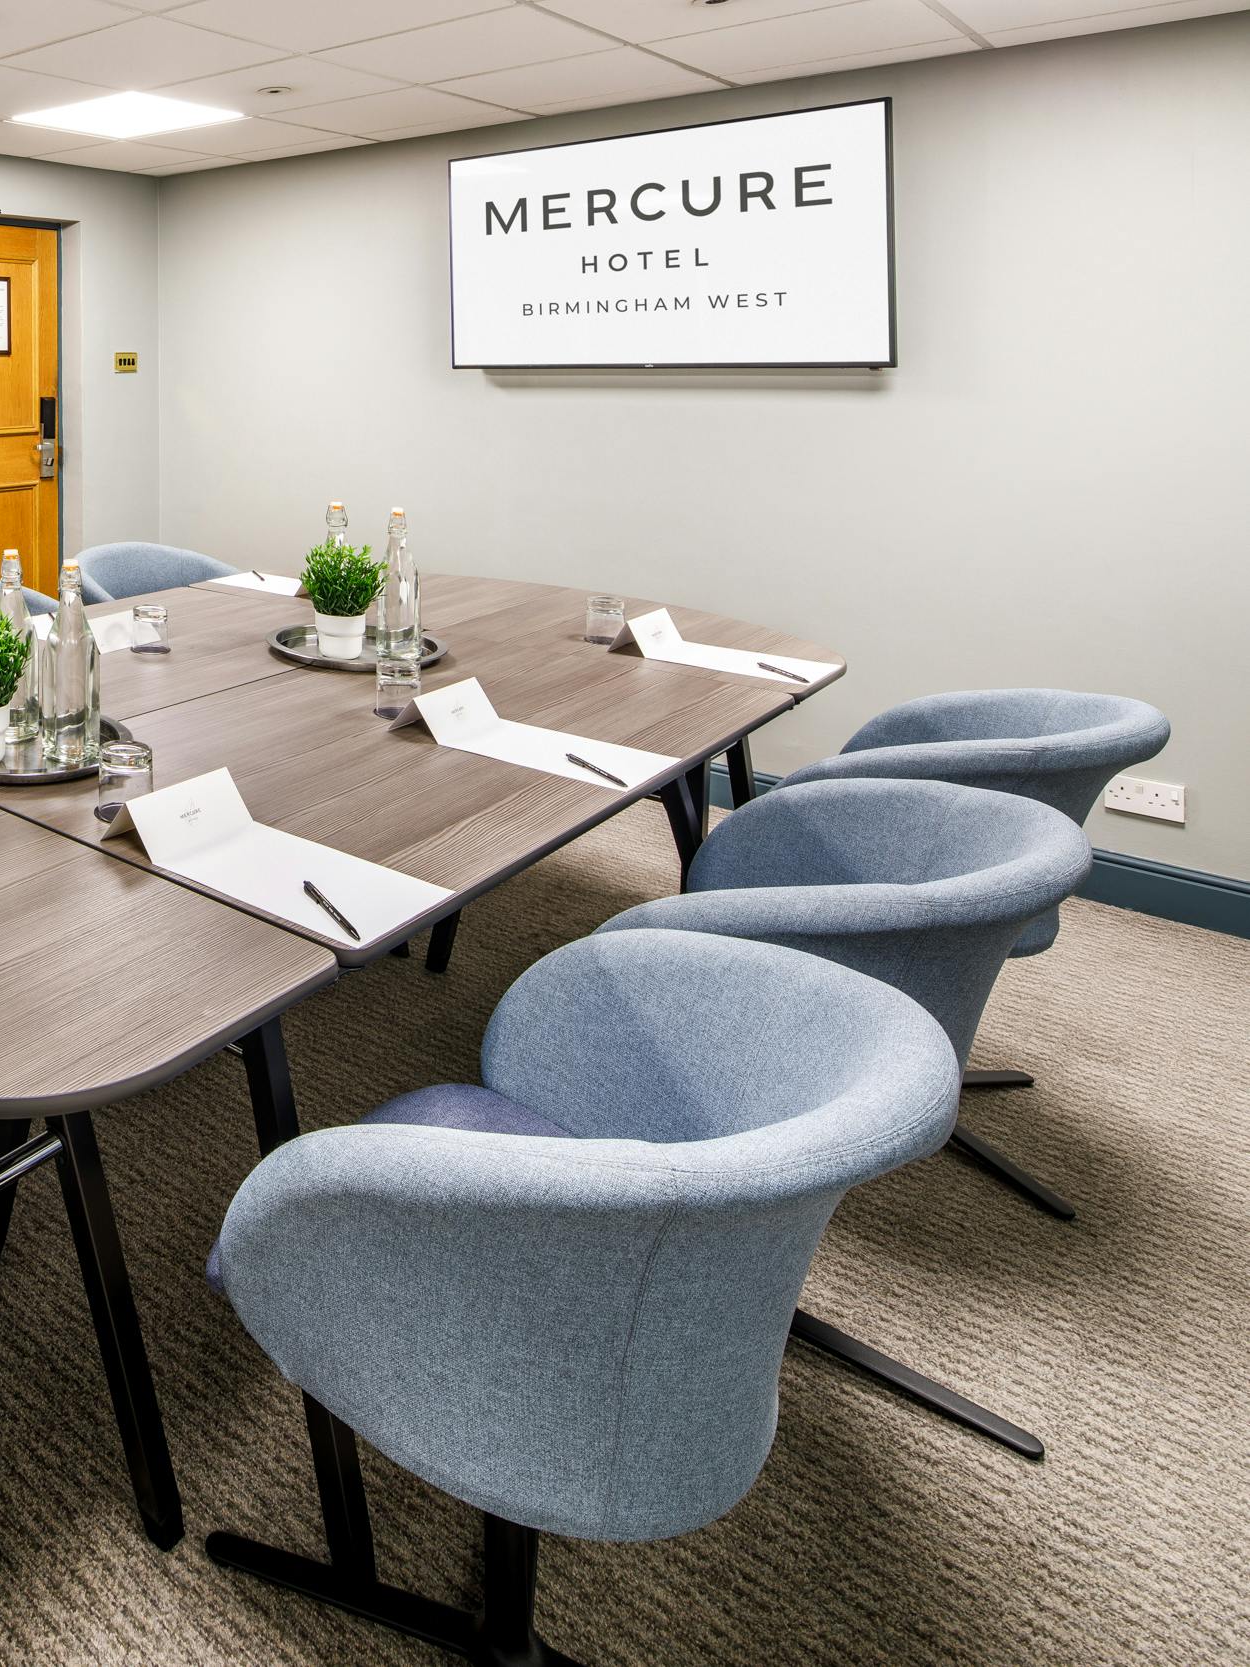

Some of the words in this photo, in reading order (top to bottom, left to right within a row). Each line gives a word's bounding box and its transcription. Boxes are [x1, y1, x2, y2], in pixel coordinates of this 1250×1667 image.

[485, 163, 833, 236] MERCURE
[581, 248, 709, 274] HOTEL
[522, 296, 691, 316] BIRMINGHAM
[708, 292, 788, 309] WEST
